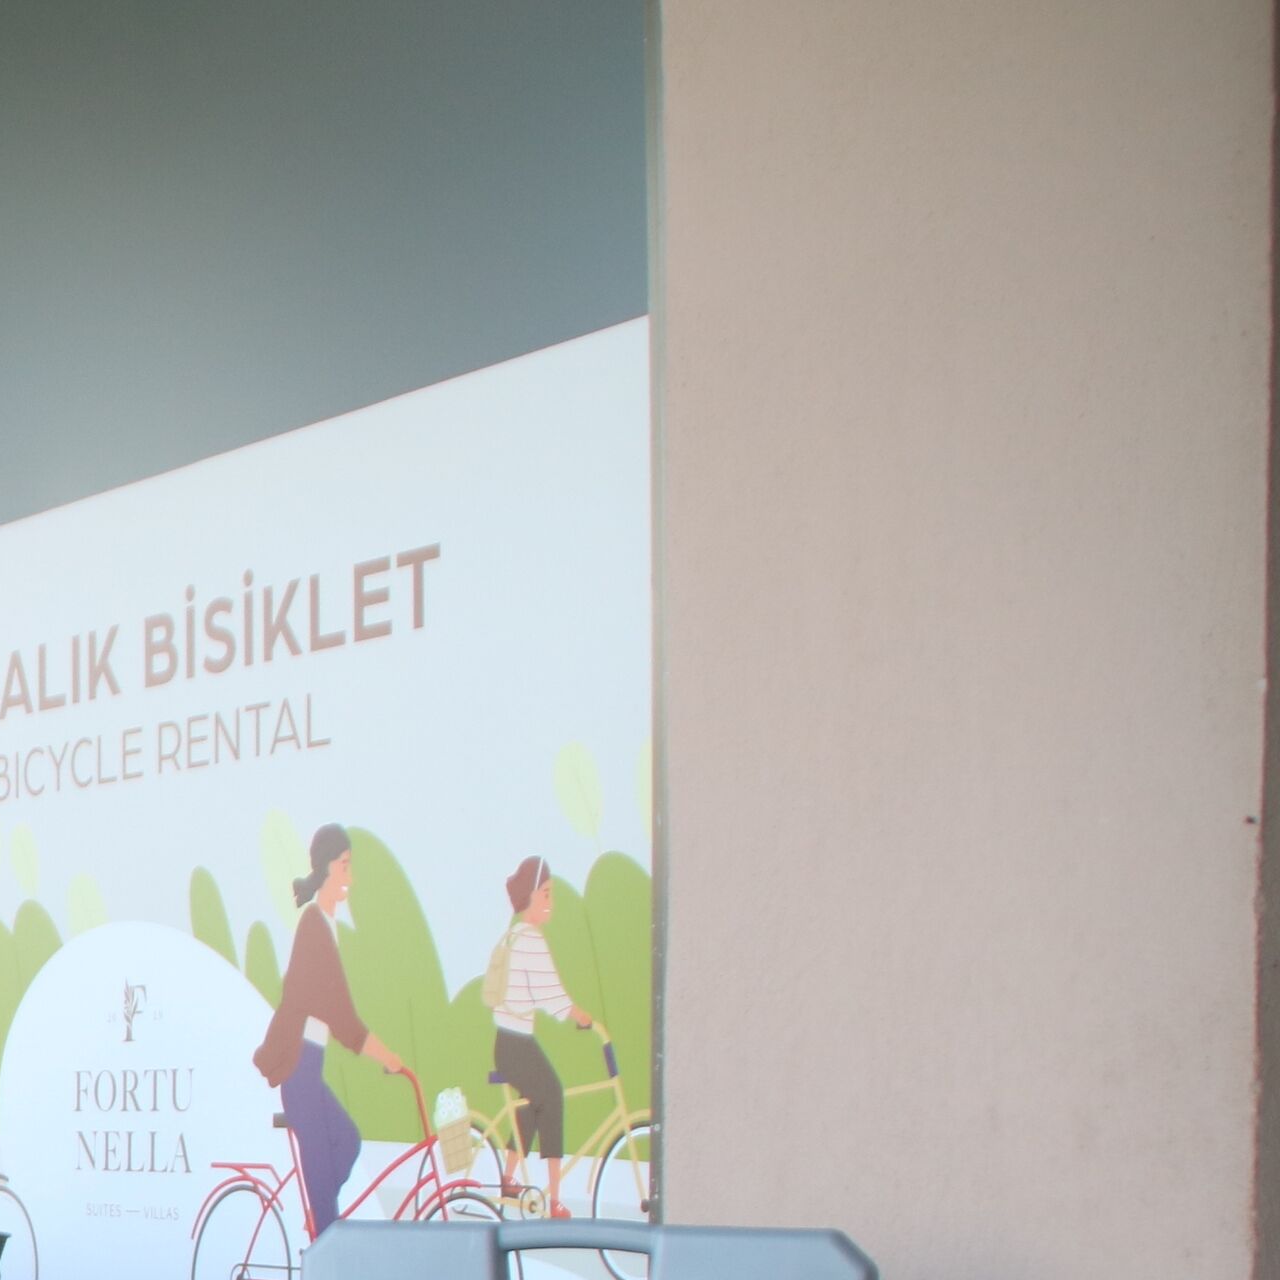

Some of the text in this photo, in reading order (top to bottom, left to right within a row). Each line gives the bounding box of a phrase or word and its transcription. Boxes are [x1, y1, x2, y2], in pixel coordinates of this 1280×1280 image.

[143, 543, 441, 689] BİSİKLET
[156, 693, 332, 777] RENTAL
[73, 1068, 195, 1112] FORTU
[75, 1131, 192, 1173] NELLA
[86, 1203, 180, 1221] SUITES VILLAS
